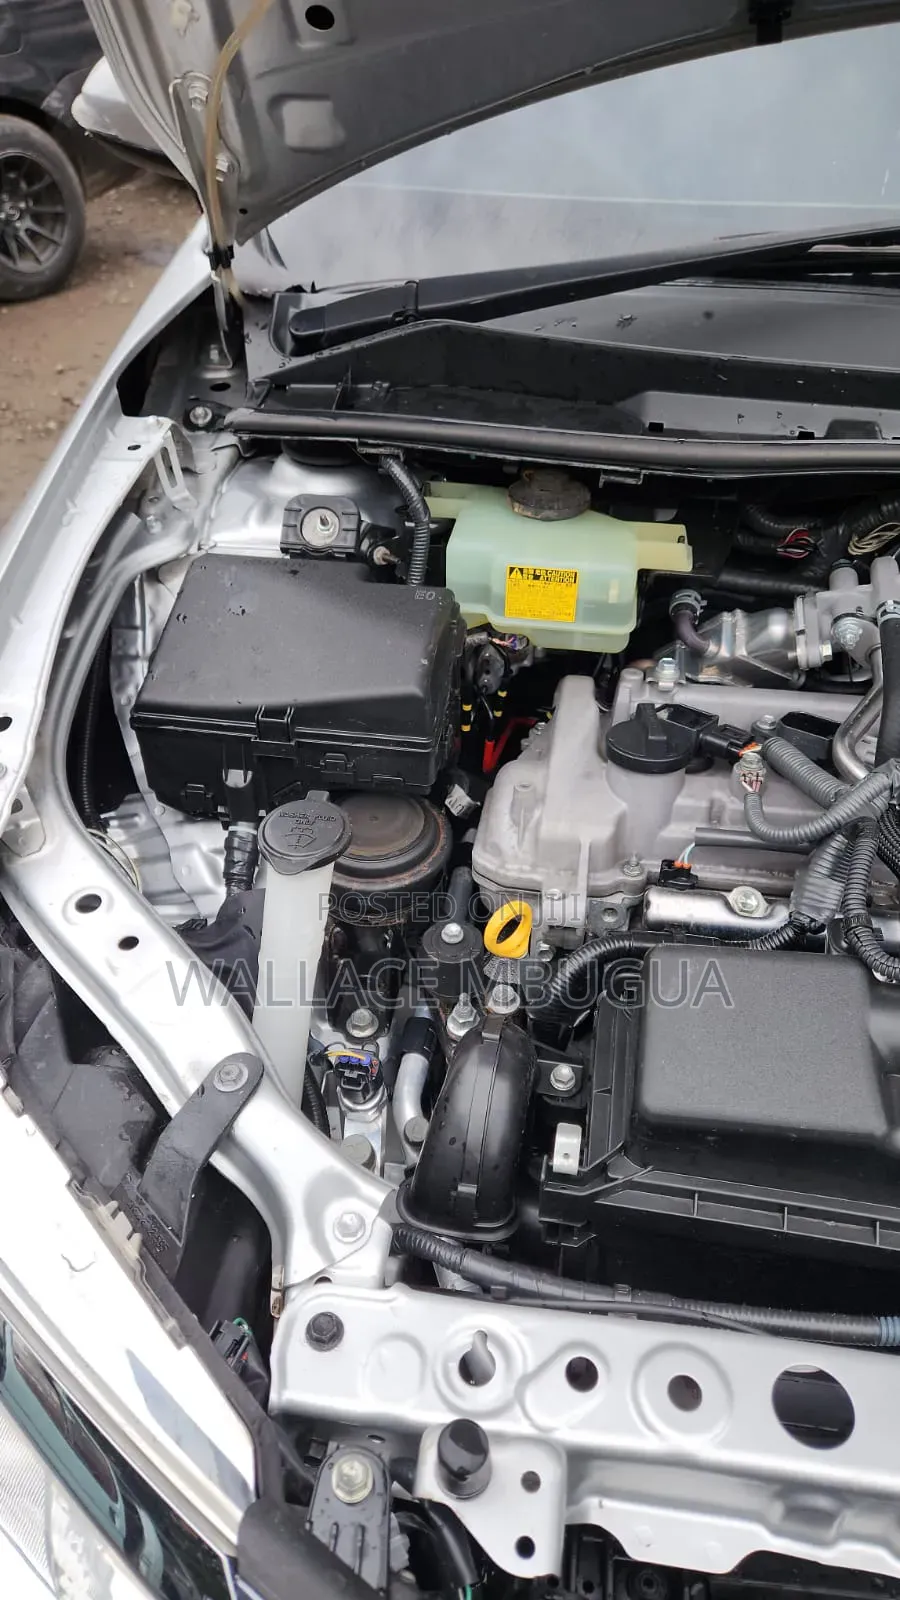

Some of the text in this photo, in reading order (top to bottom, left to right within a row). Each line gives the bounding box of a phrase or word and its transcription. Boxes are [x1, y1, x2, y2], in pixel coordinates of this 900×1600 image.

[547, 570, 575, 578] CAUTION
[540, 575, 575, 583] ATTENTION
[295, 818, 316, 826] ONLY
